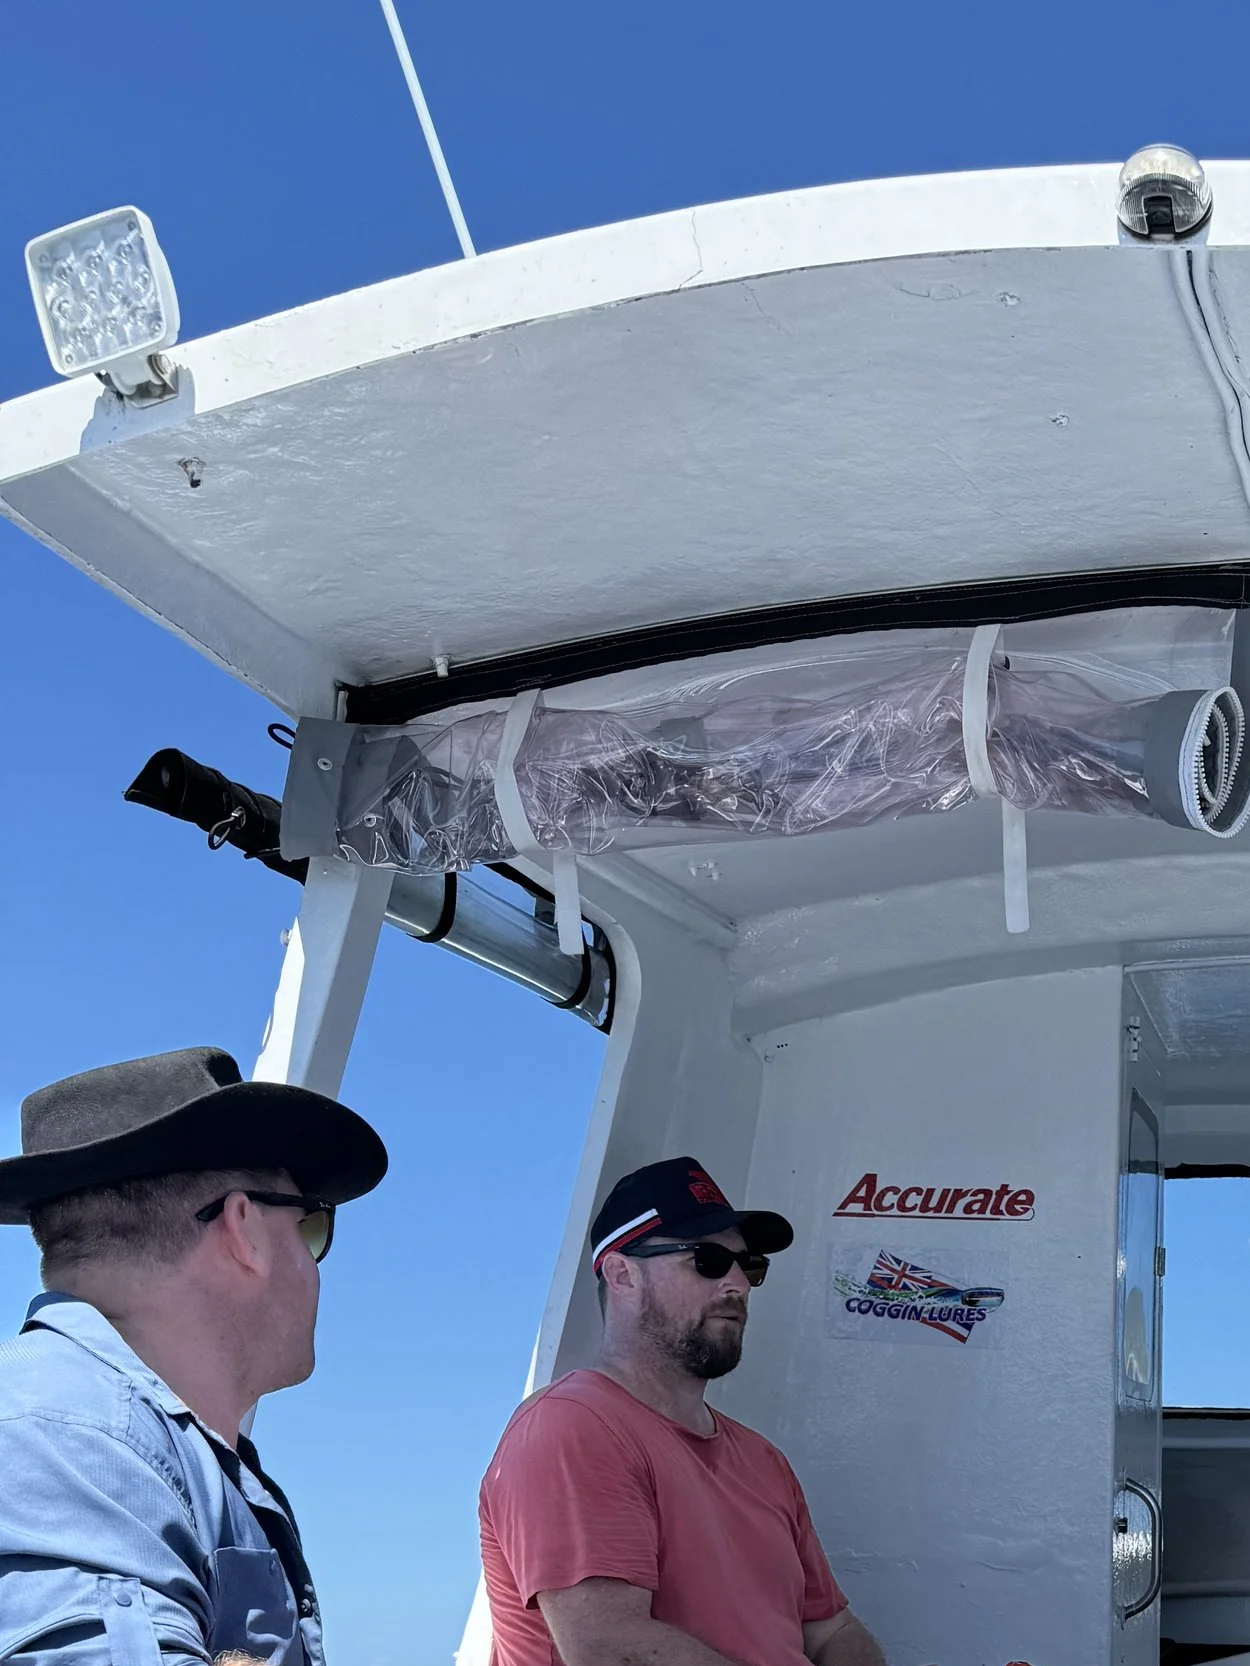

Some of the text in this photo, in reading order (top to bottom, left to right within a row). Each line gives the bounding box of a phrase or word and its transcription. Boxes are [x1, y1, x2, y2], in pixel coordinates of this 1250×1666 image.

[836, 1173, 1035, 1218] Accurate
[845, 1297, 987, 1322] COGGIN LURES
